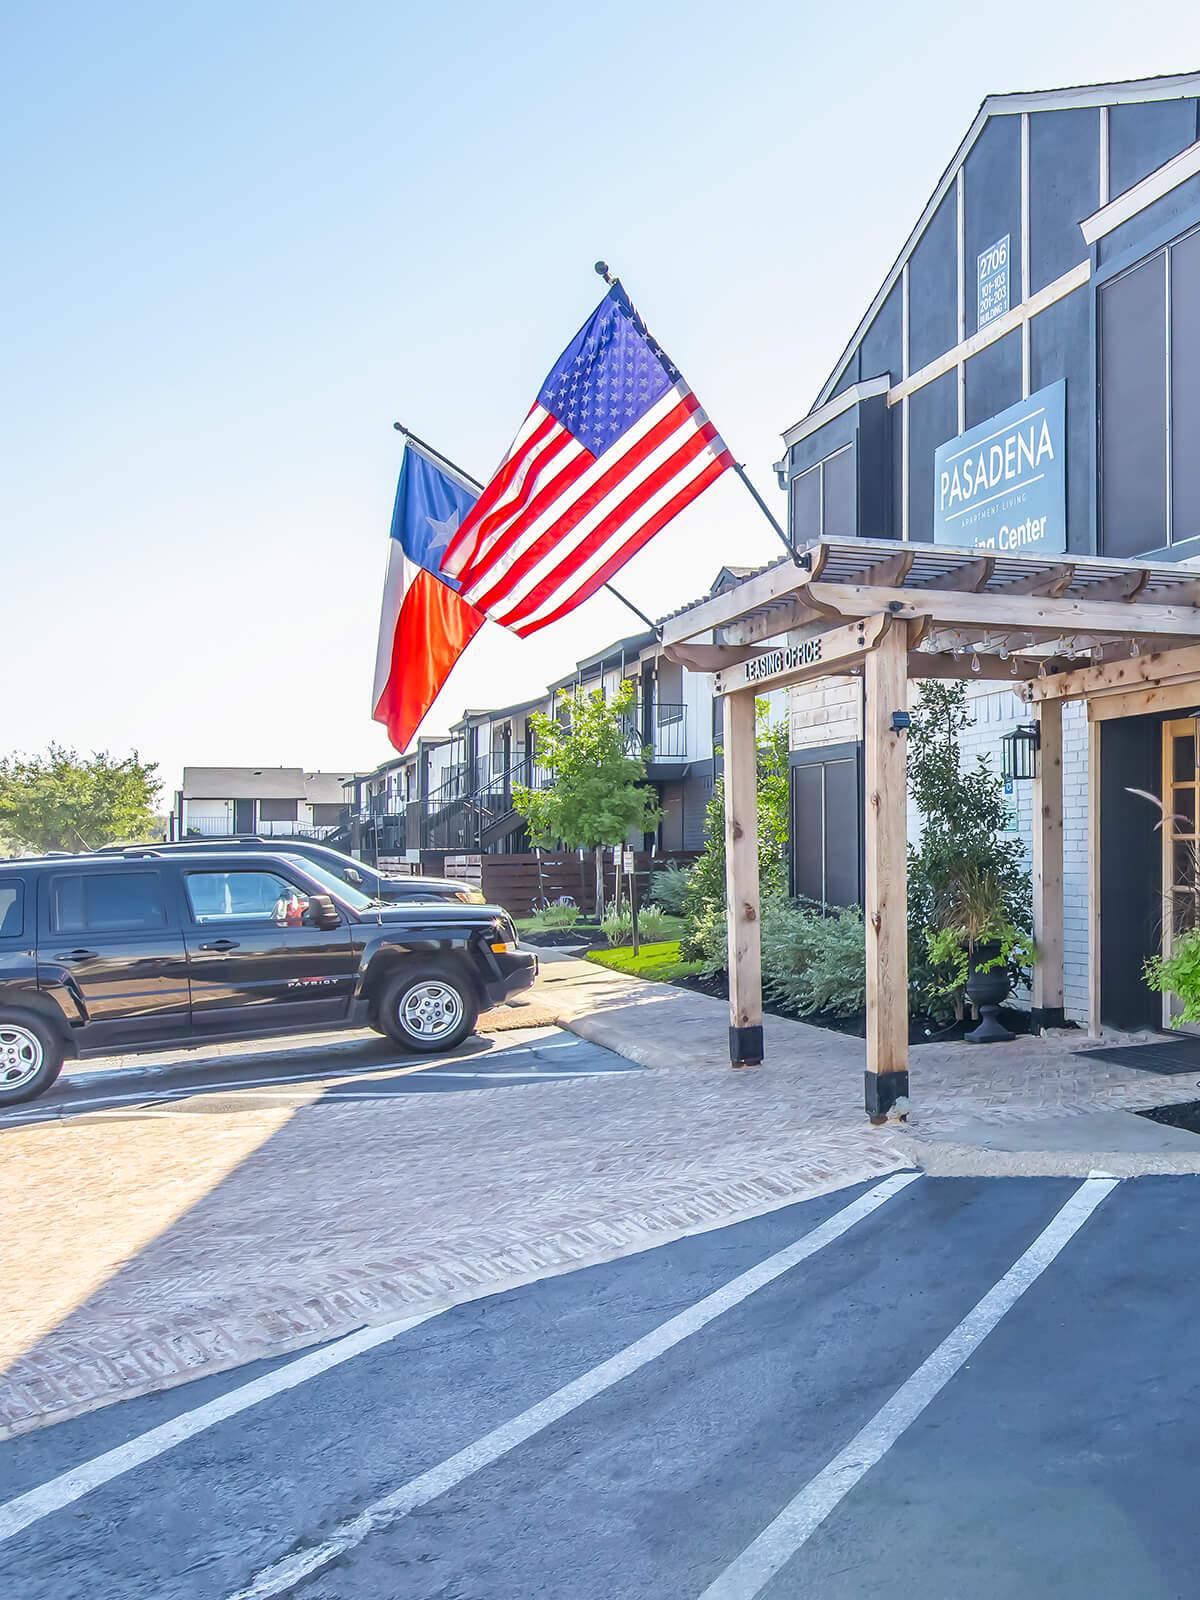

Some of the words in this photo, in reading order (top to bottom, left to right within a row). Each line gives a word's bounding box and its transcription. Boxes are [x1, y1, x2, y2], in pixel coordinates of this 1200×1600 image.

[980, 243, 1007, 280] 2706
[940, 418, 1055, 512] PASADENA
[999, 515, 1047, 550] Center
[744, 651, 783, 681] LEASING
[784, 639, 822, 669] OFFICE
[288, 978, 339, 988] PATRIOT
